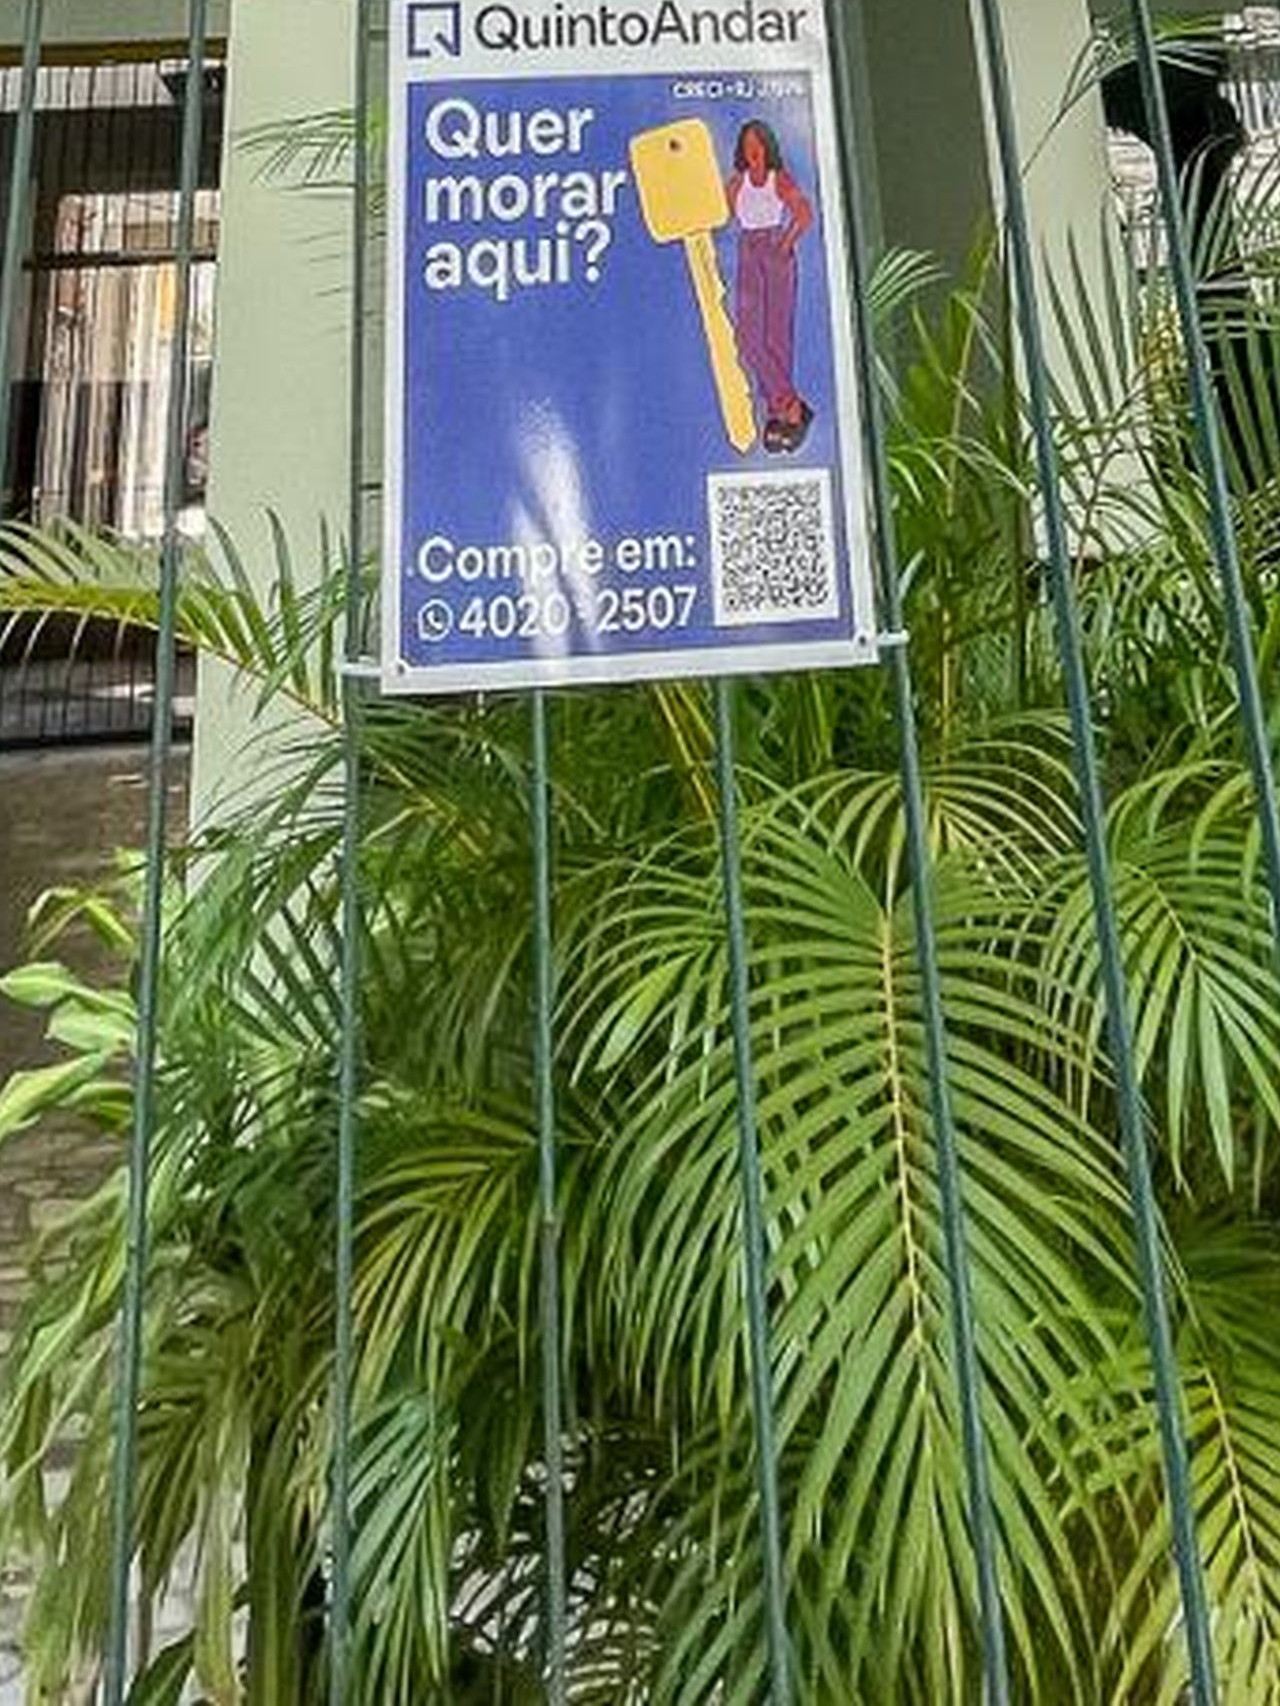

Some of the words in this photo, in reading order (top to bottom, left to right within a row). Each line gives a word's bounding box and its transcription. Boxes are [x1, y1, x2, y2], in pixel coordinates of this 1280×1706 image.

[426, 99, 593, 158] Quer
[426, 170, 626, 222] morar
[425, 220, 611, 301] aqui?
[419, 537, 603, 587] Compre
[617, 535, 697, 572] em:
